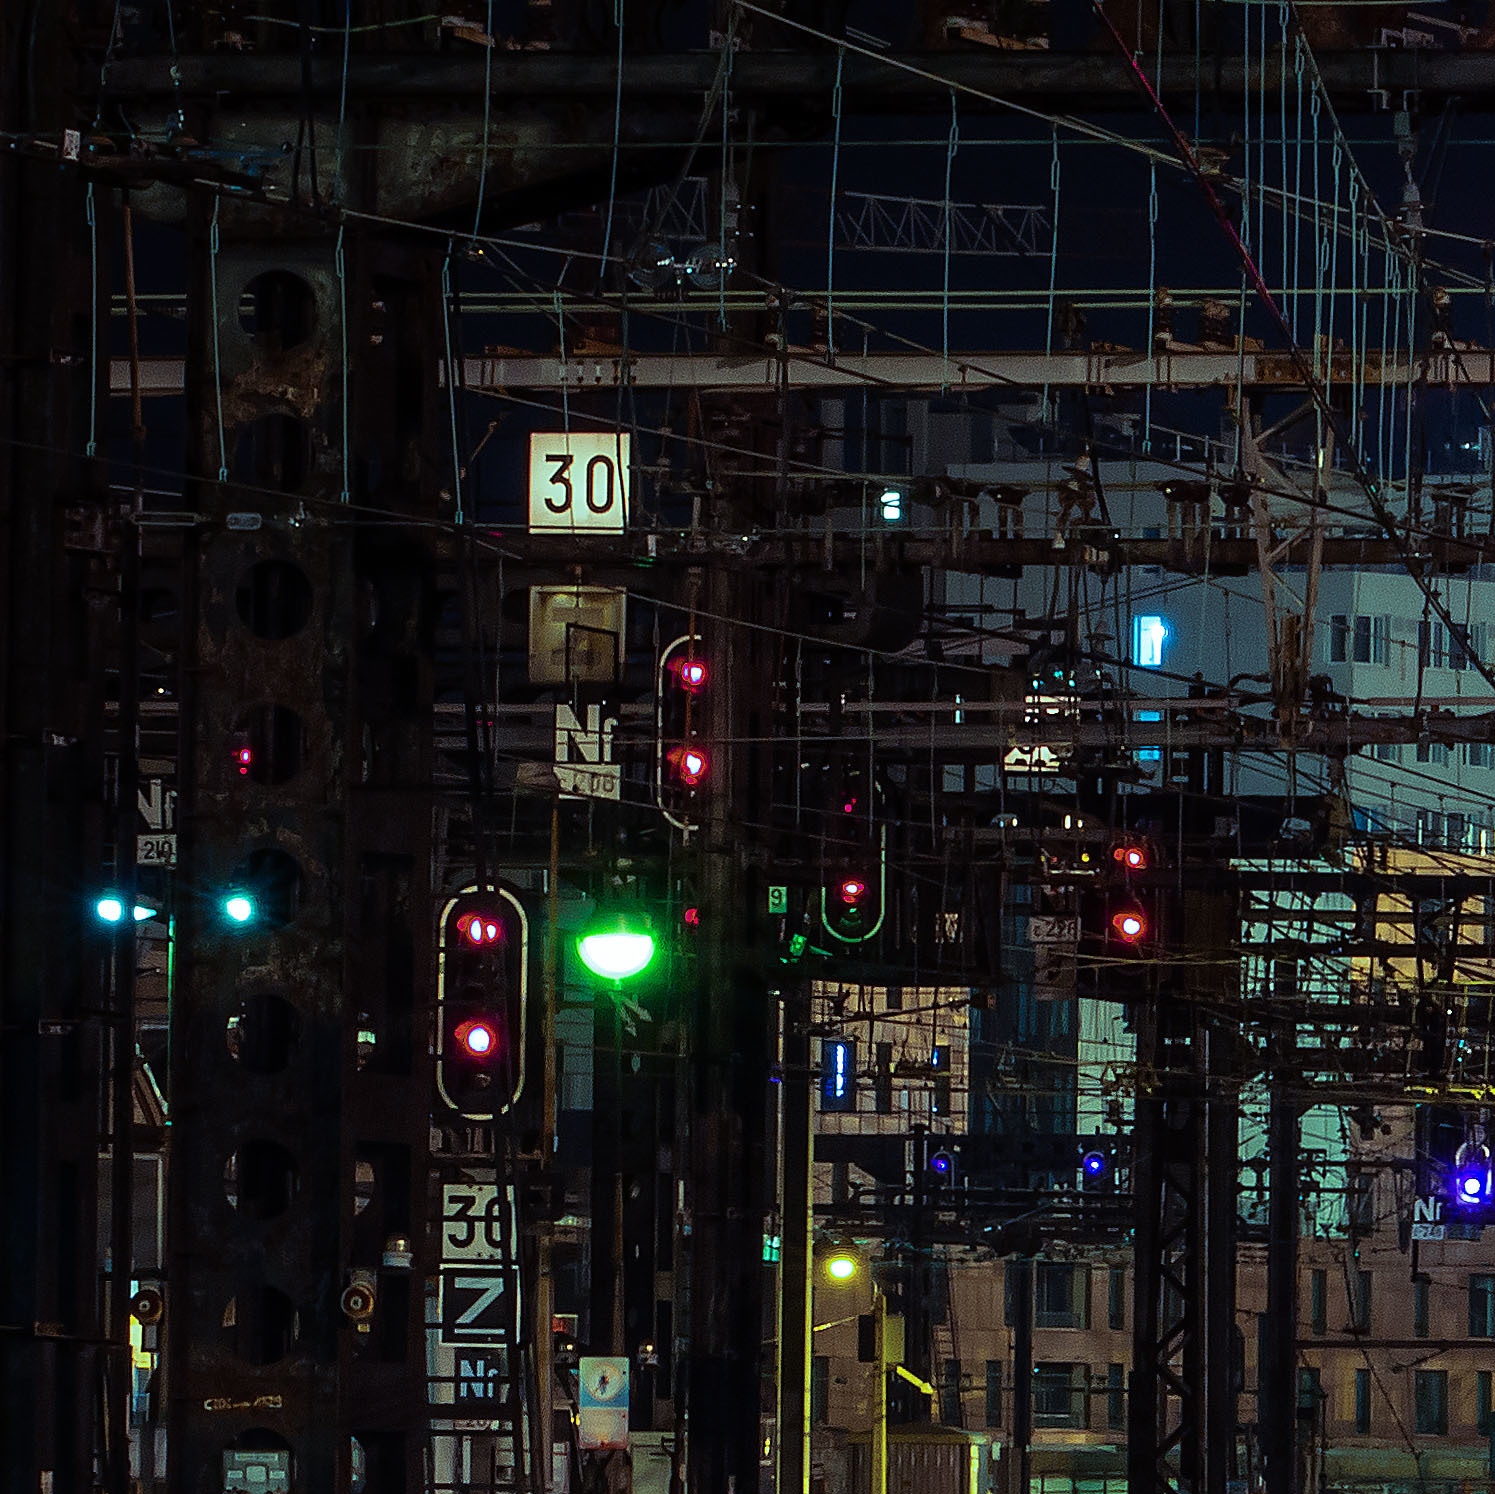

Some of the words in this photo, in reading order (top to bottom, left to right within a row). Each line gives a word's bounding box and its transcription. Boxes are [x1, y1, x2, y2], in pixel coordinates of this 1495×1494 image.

[544, 454, 614, 513] 30
[555, 703, 619, 762] Nf
[448, 1195, 513, 1248] 30
[454, 1276, 506, 1335] Z
